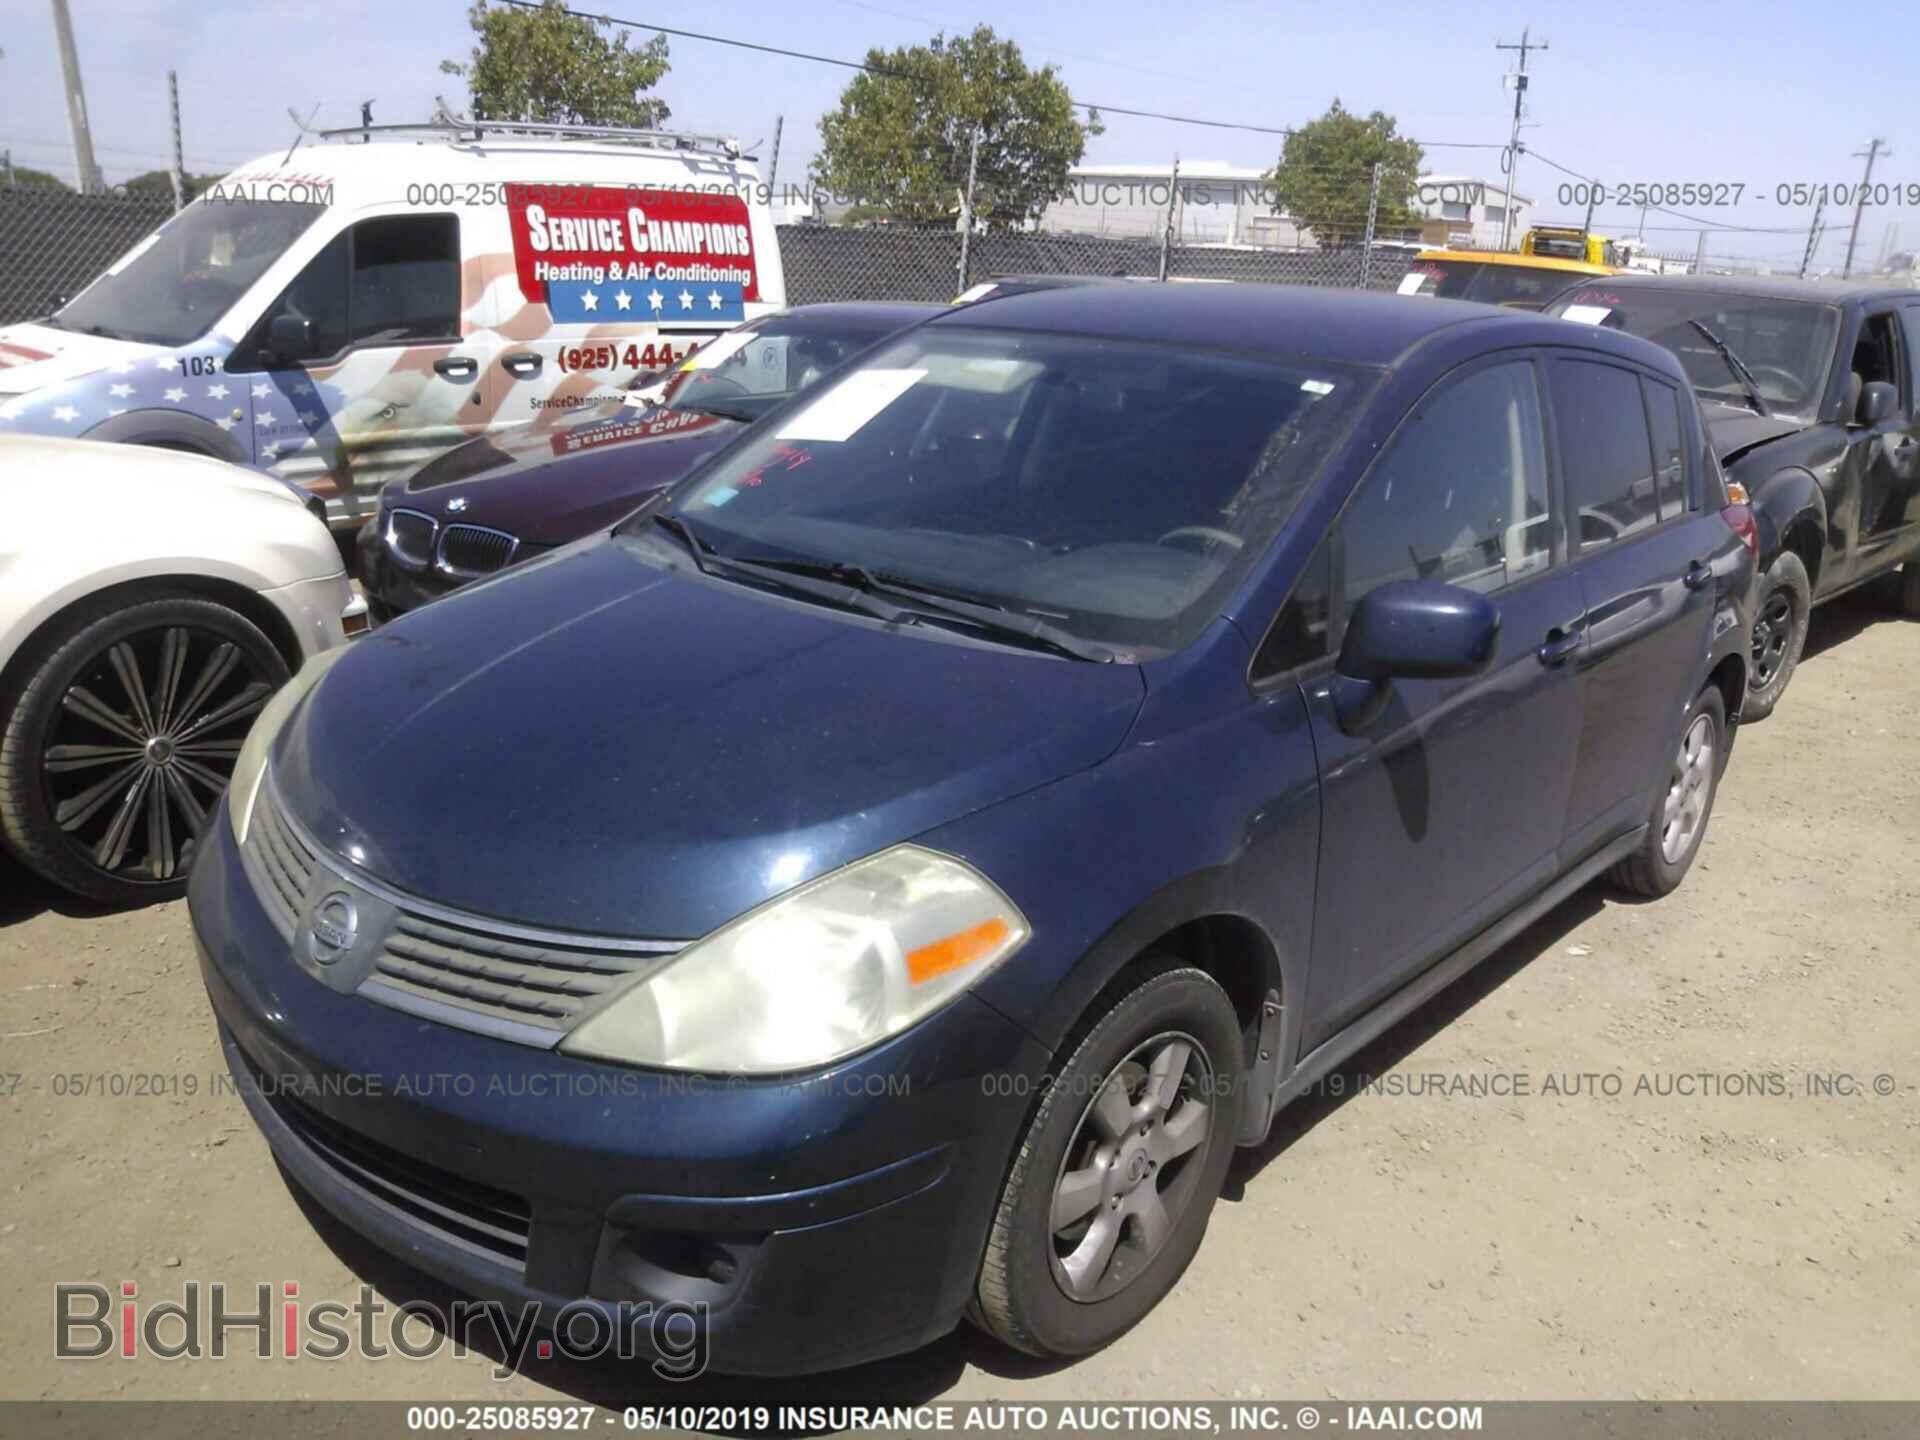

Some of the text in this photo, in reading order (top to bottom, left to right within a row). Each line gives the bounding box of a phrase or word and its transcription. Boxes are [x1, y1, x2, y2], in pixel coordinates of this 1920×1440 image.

[526, 204, 750, 256] SERVICE CHAMPIONS
[534, 261, 751, 287] Heating & Air Conditioning
[178, 356, 216, 377] 103
[558, 345, 618, 373] (925)
